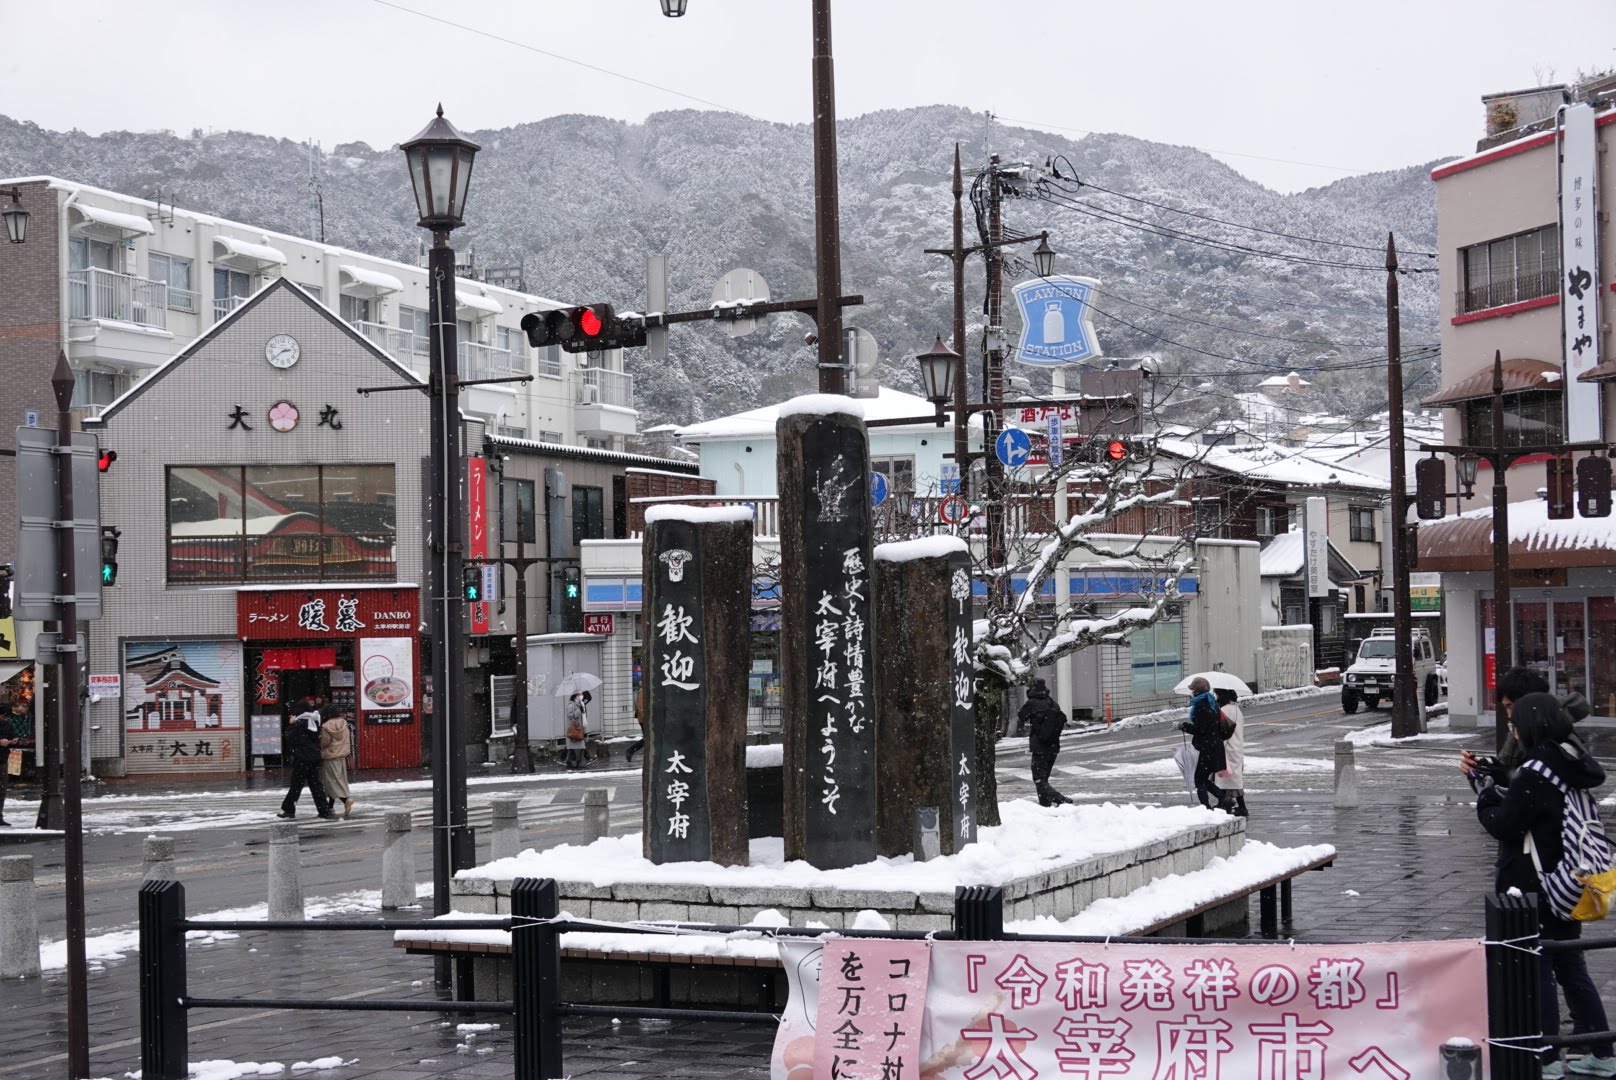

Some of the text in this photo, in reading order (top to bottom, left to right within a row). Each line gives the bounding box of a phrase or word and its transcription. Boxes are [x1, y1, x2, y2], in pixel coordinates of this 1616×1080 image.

[1574, 176, 1583, 249] 博多の味
[1023, 286, 1083, 304] LAWSON
[1568, 264, 1592, 356] やまや
[1025, 340, 1084, 356] STATION
[473, 467, 483, 541] ラーメン
[1309, 531, 1319, 593] やすたけ美容室
[248, 598, 411, 632] ラーメン 暖暮 DANBO
[588, 624, 611, 632] ATM
[842, 546, 866, 734] 歴史と詩情豊かな
[656, 603, 701, 839] 歓迎 太宰府
[814, 590, 843, 815] 太宰府へようこそ
[952, 625, 973, 839] 歓迎 太宰府
[170, 739, 213, 757] 大丸
[832, 951, 866, 1080] を万全に
[966, 953, 1399, 1012] 「令和発祥の都」
[881, 959, 911, 1080] コロナ対
[960, 1012, 1411, 1080] 太宰府市へ
